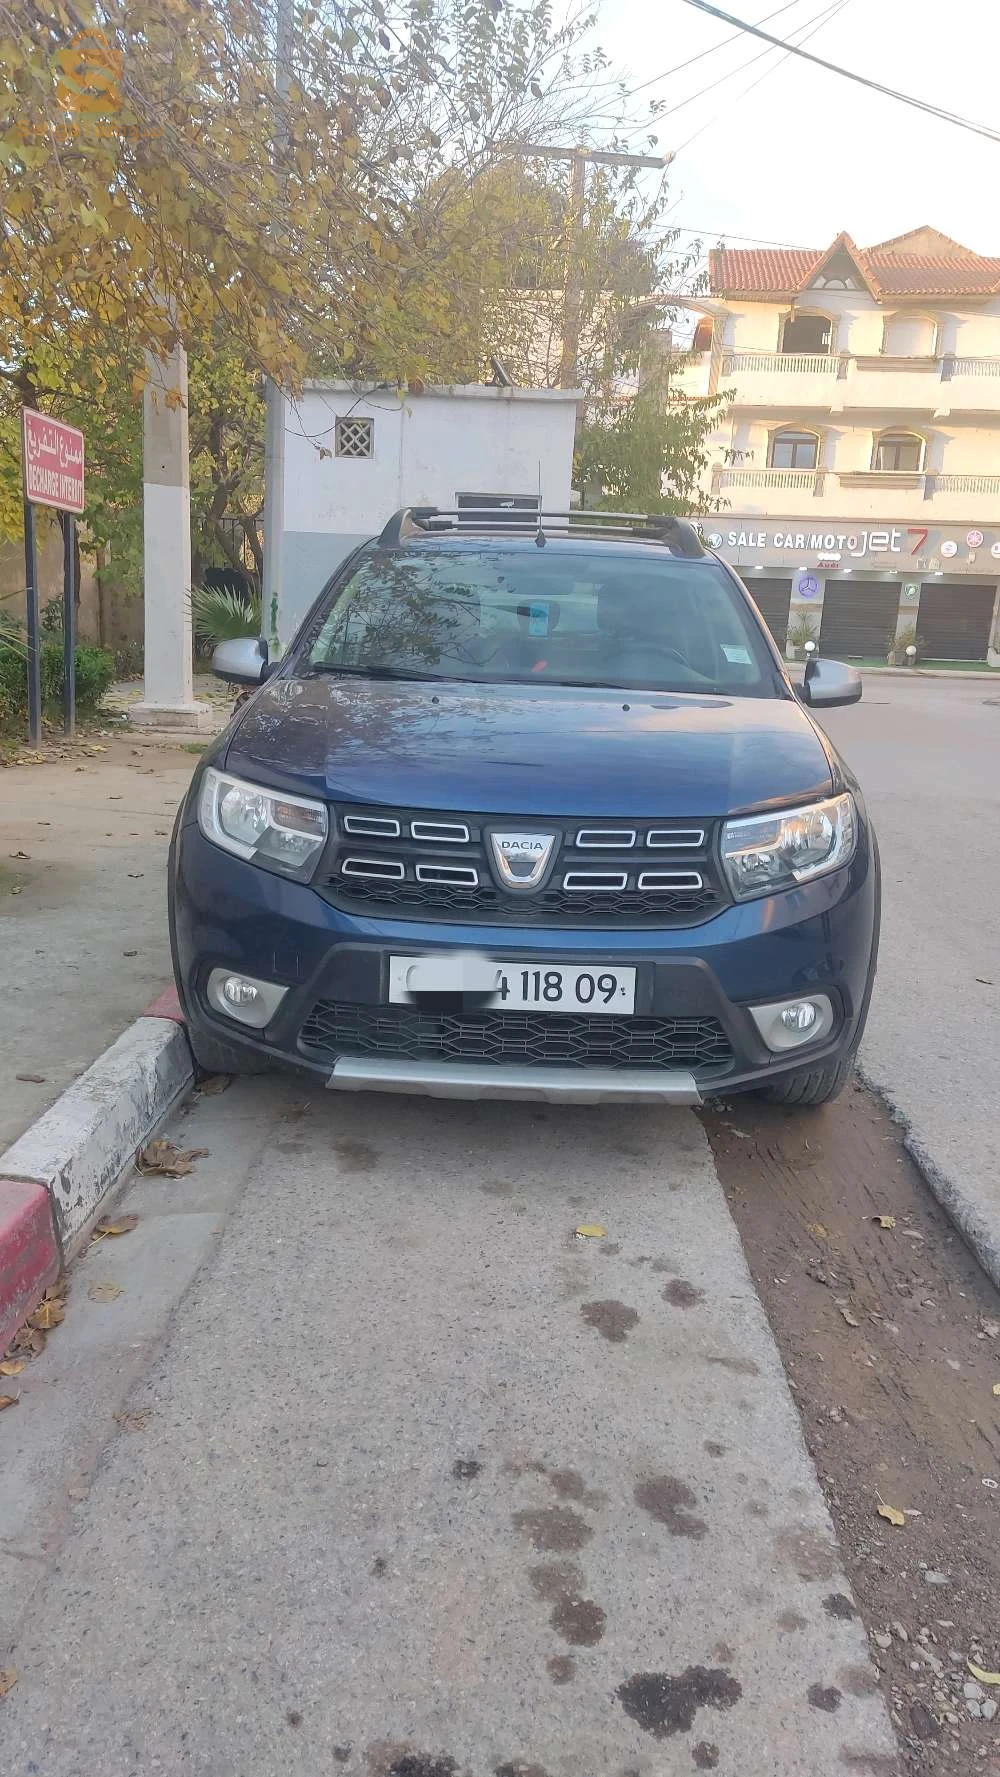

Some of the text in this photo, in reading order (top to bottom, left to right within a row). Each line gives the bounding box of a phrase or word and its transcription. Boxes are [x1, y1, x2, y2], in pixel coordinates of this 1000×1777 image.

[27, 420, 82, 468] ممنوع التفريغ
[29, 463, 59, 498] DECHARGE
[727, 531, 767, 548] SALE
[907, 528, 928, 556] 7
[816, 561, 840, 569] Audi
[501, 841, 543, 850] DACIA
[521, 970, 563, 1002] 118
[575, 973, 618, 1004] 09
